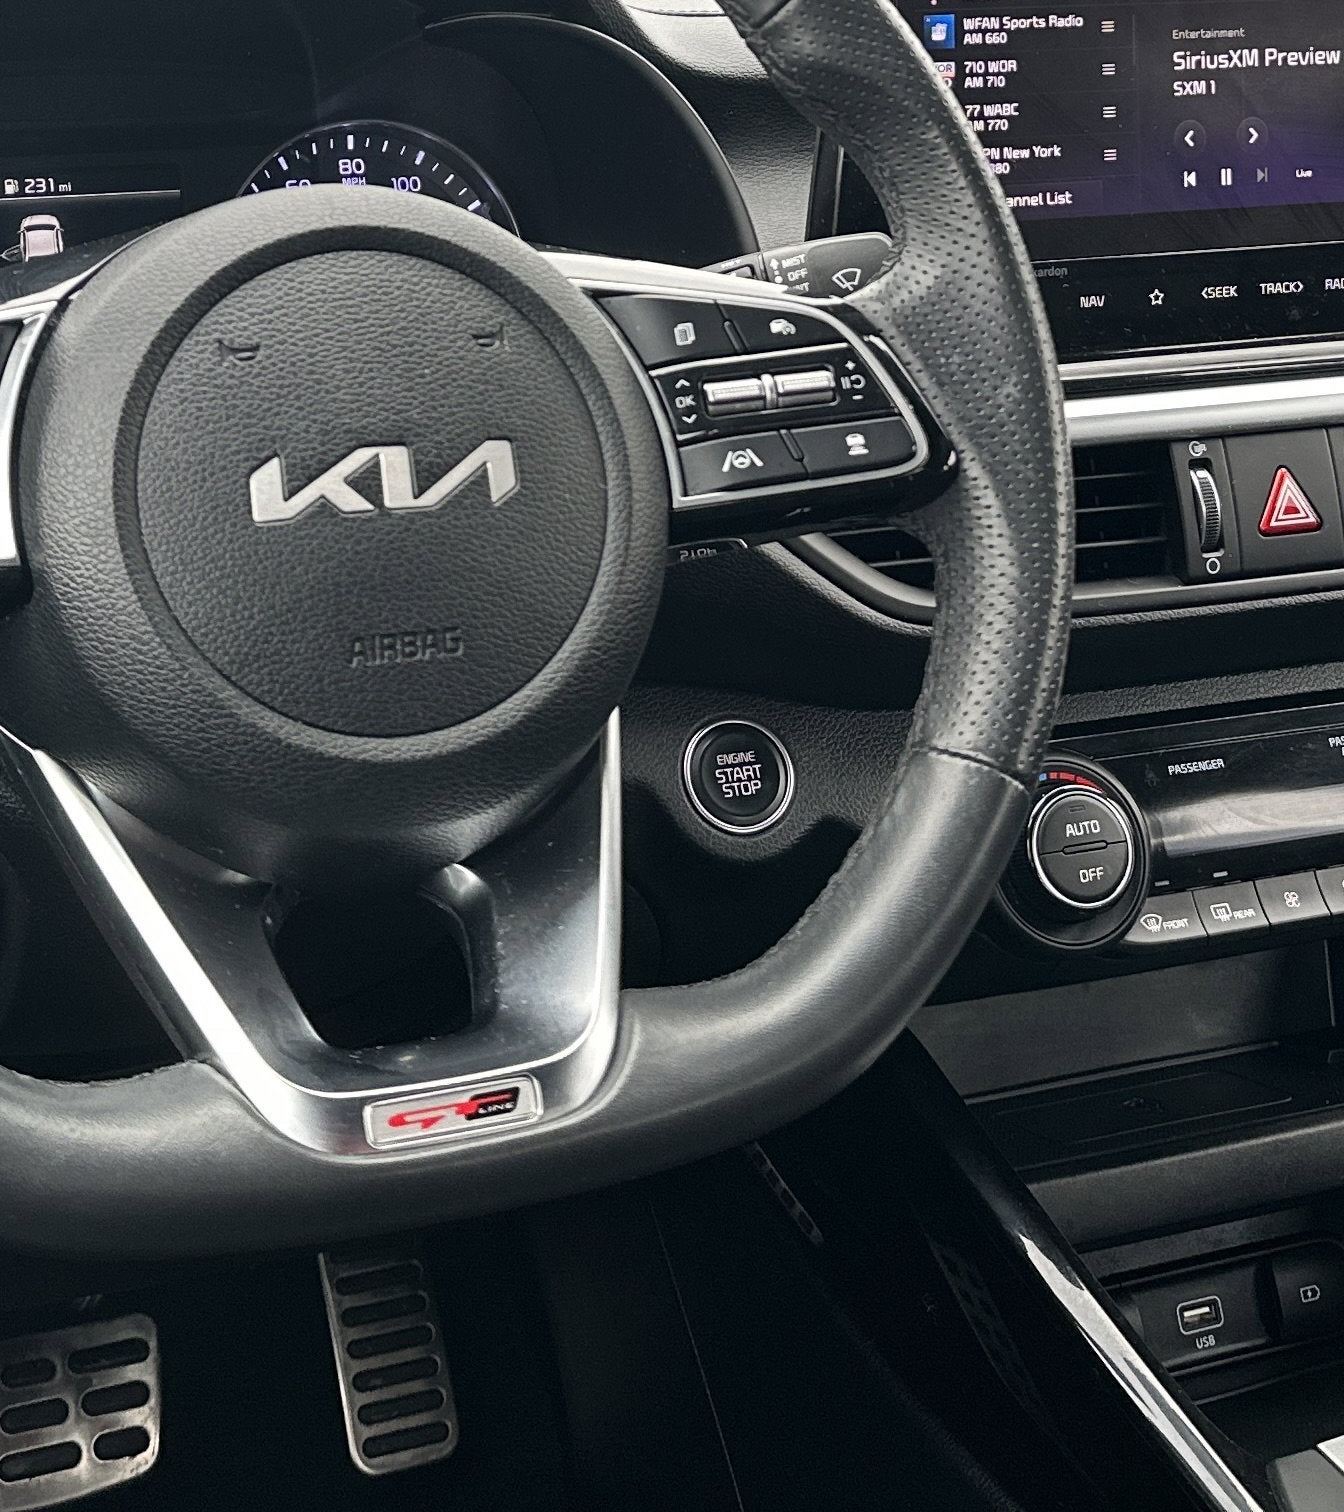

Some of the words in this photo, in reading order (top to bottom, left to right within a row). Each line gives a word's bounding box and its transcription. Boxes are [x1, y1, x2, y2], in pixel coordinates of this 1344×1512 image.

[963, 16, 1000, 31] WFAN
[1002, 15, 1047, 32] Sports
[1049, 14, 1084, 29] Radio
[963, 33, 983, 45] AM
[985, 32, 1008, 45] 660
[1172, 27, 1246, 40] Entertainment
[1172, 48, 1259, 71] SiriusXM
[1265, 46, 1341, 68] Preview
[964, 61, 985, 75] 710
[987, 59, 1018, 73] WOR
[964, 76, 984, 89] AM
[986, 75, 1005, 88] 710
[1173, 80, 1207, 97] SXM
[1209, 80, 1216, 96] 1
[964, 104, 981, 118] 77
[983, 102, 1020, 117] WABC
[987, 119, 1009, 131] 770
[982, 147, 1001, 160] PN
[1003, 146, 1031, 159] New
[1032, 144, 1062, 158] York
[338, 158, 365, 175] 80
[24, 177, 55, 194] 231
[58, 181, 72, 193] mi
[390, 176, 421, 192] 100
[1006, 192, 1044, 207] annel
[1046, 190, 1073, 205] List
[1080, 294, 1105, 308] NAV
[675, 393, 696, 409] OK
[249, 438, 519, 526] KIA
[351, 629, 464, 668] AIRBAG
[716, 750, 756, 766] ENGINE
[715, 763, 762, 784] START
[1167, 758, 1225, 776] PASSENGER
[722, 779, 762, 798] STOP
[1065, 819, 1101, 838] AUTO
[1079, 866, 1104, 883] OFF
[1232, 908, 1257, 920] REAR
[1162, 917, 1189, 930] FRONT
[1195, 1334, 1217, 1349] USB
